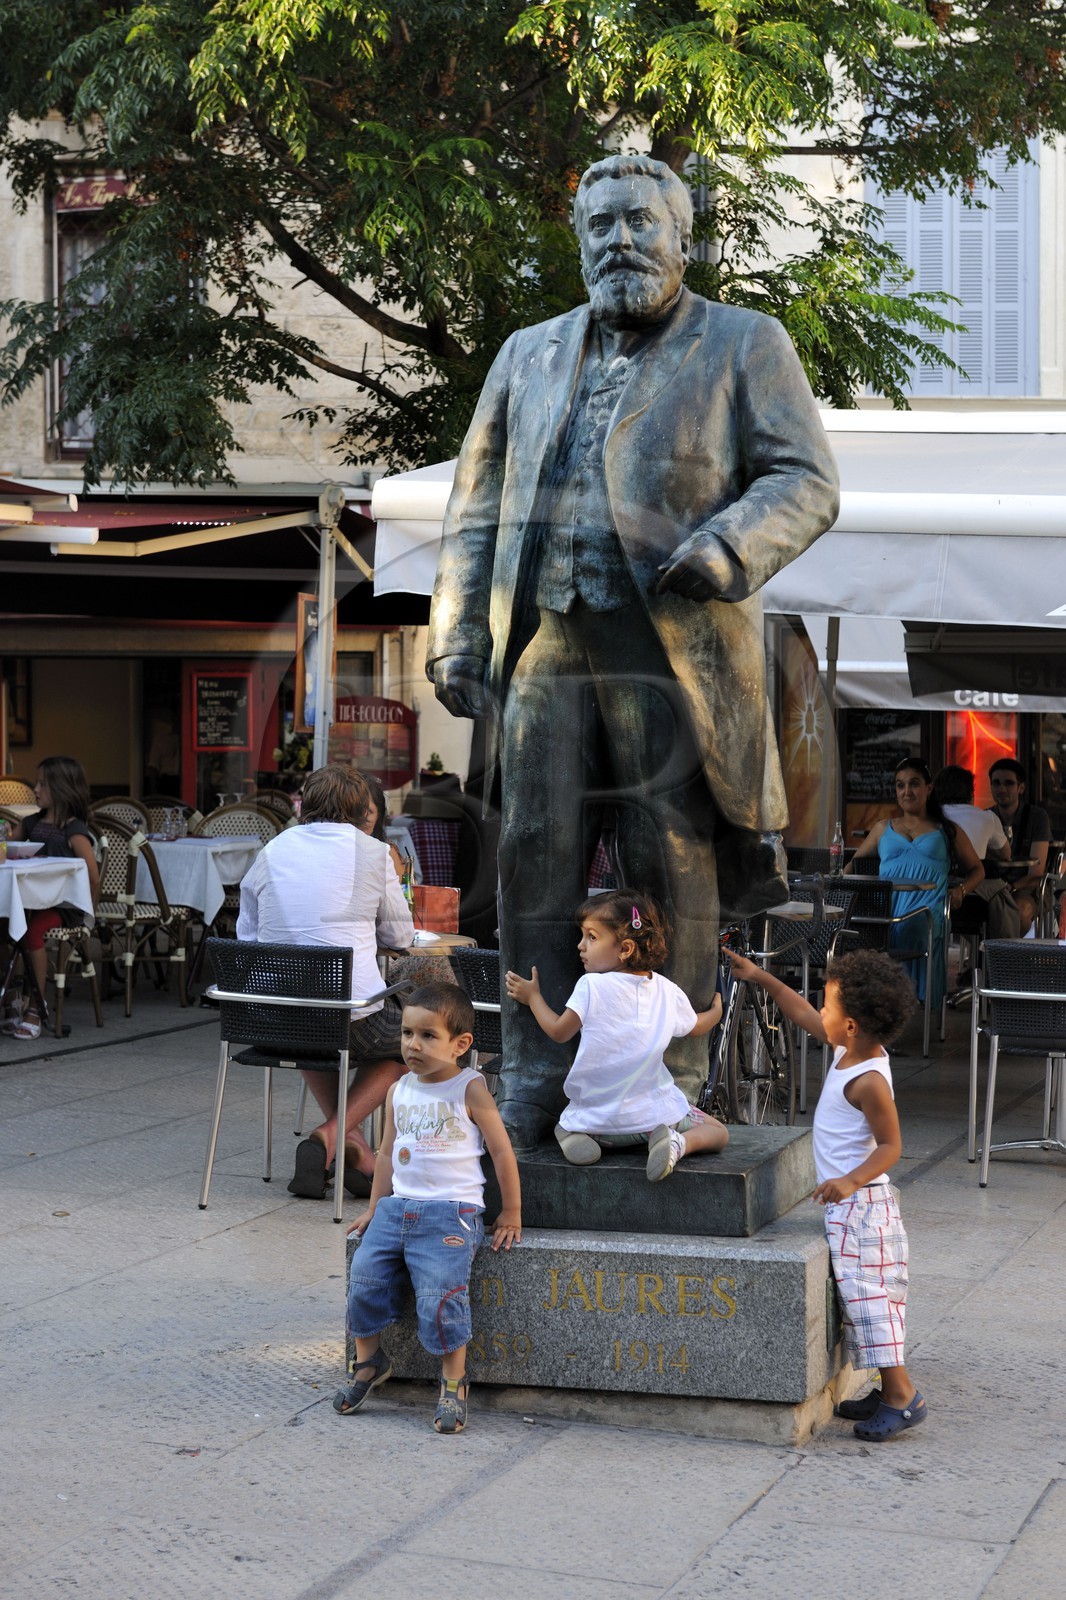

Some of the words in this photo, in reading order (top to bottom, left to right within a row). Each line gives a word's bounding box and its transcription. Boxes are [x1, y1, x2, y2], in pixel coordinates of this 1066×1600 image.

[339, 704, 404, 722] TIRE-BOUCHON
[542, 1266, 738, 1319] JAURES
[467, 1326, 532, 1365] 859
[612, 1338, 691, 1375] 1914
